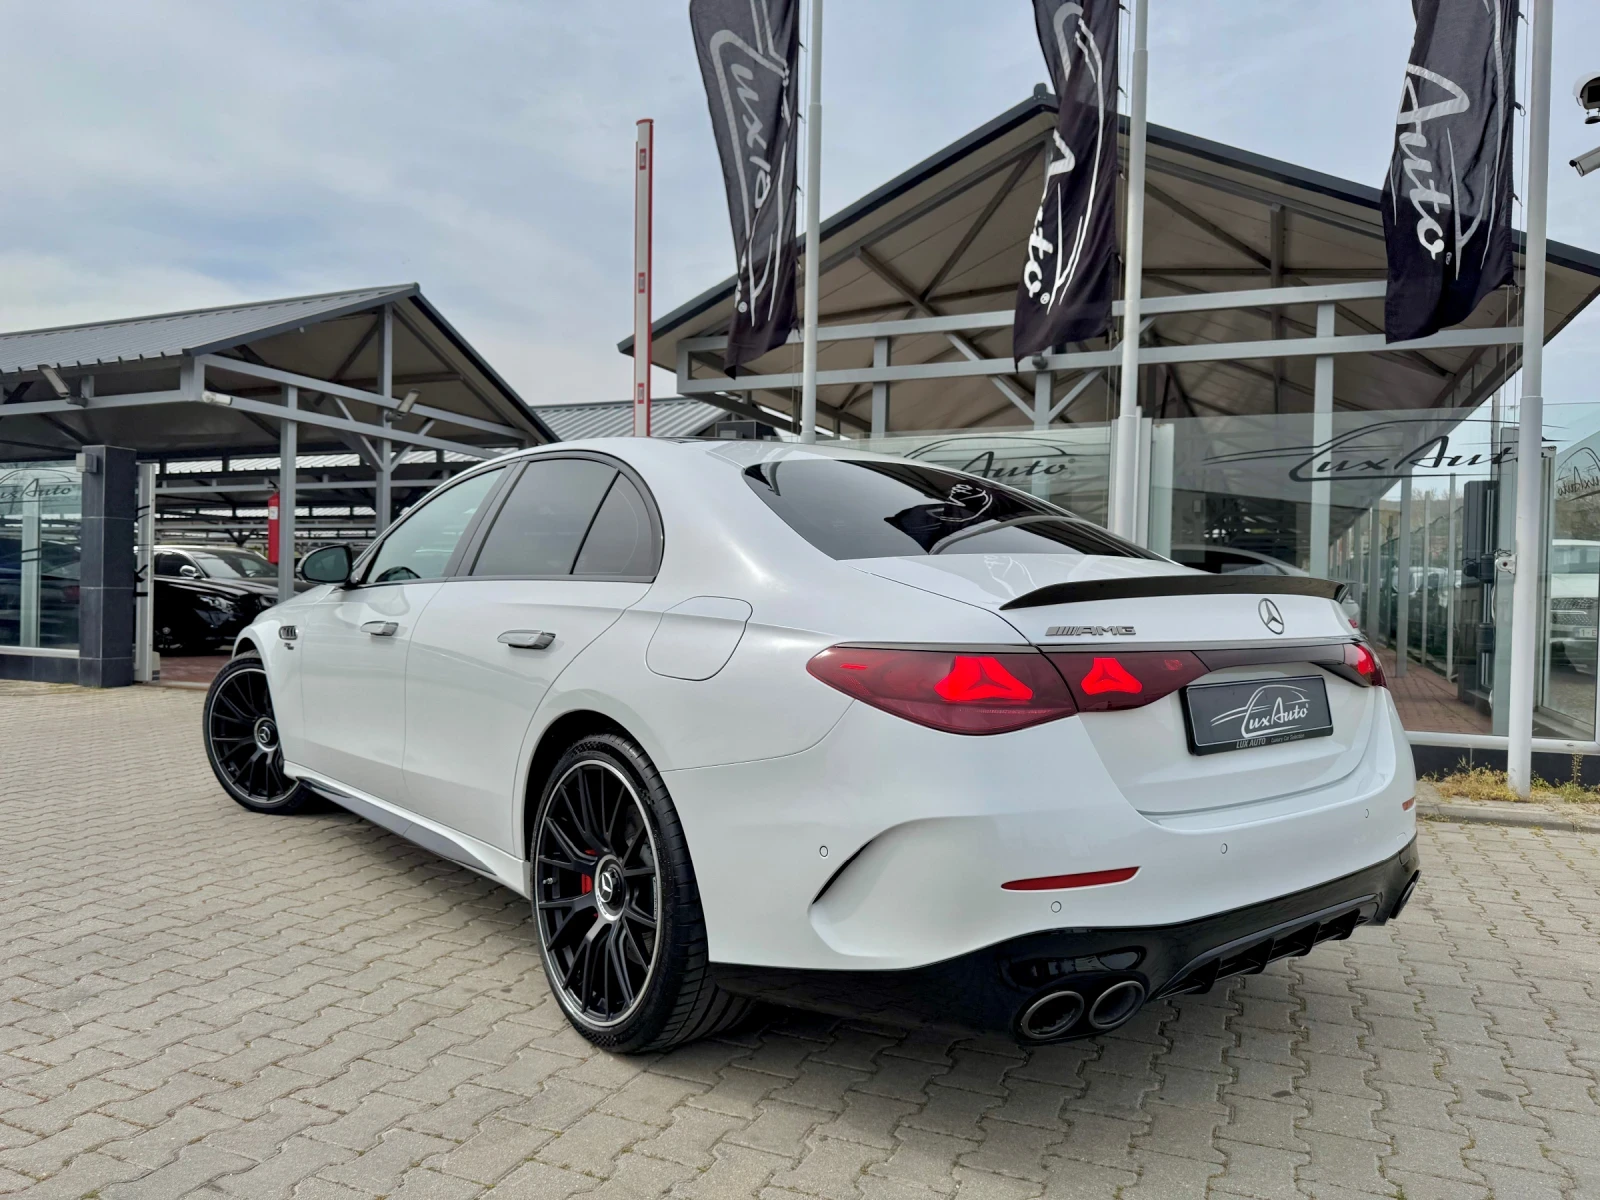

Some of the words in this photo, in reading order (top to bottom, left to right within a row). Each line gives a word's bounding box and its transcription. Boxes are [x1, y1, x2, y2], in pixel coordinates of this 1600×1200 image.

[1397, 63, 1470, 260] Auto
[961, 450, 1069, 479] Auto
[1394, 435, 1520, 470] Aut
[1075, 625, 1137, 637] AMG
[1271, 697, 1309, 726] Auto
[1236, 739, 1249, 748] LUX
[1249, 738, 1266, 747] AUTO
